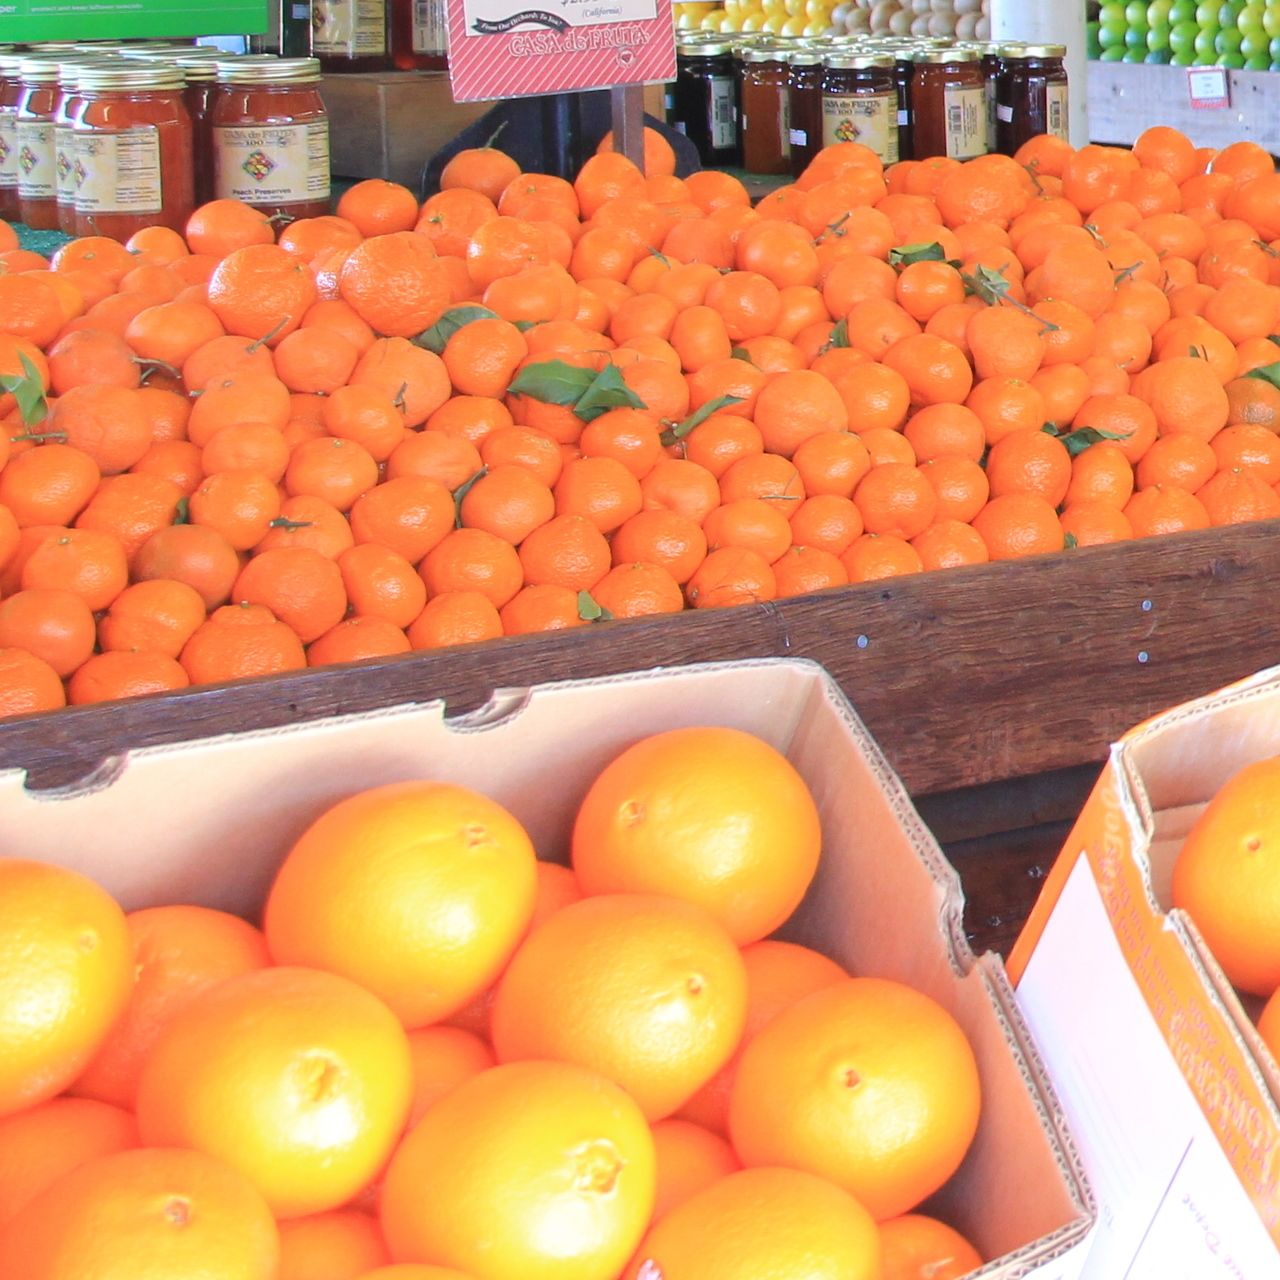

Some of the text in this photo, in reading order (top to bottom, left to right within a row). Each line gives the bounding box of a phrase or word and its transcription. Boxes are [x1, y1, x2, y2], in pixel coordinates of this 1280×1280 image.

[582, 7, 622, 18] (California)
[508, 26, 650, 57] CASA de FRUTA
